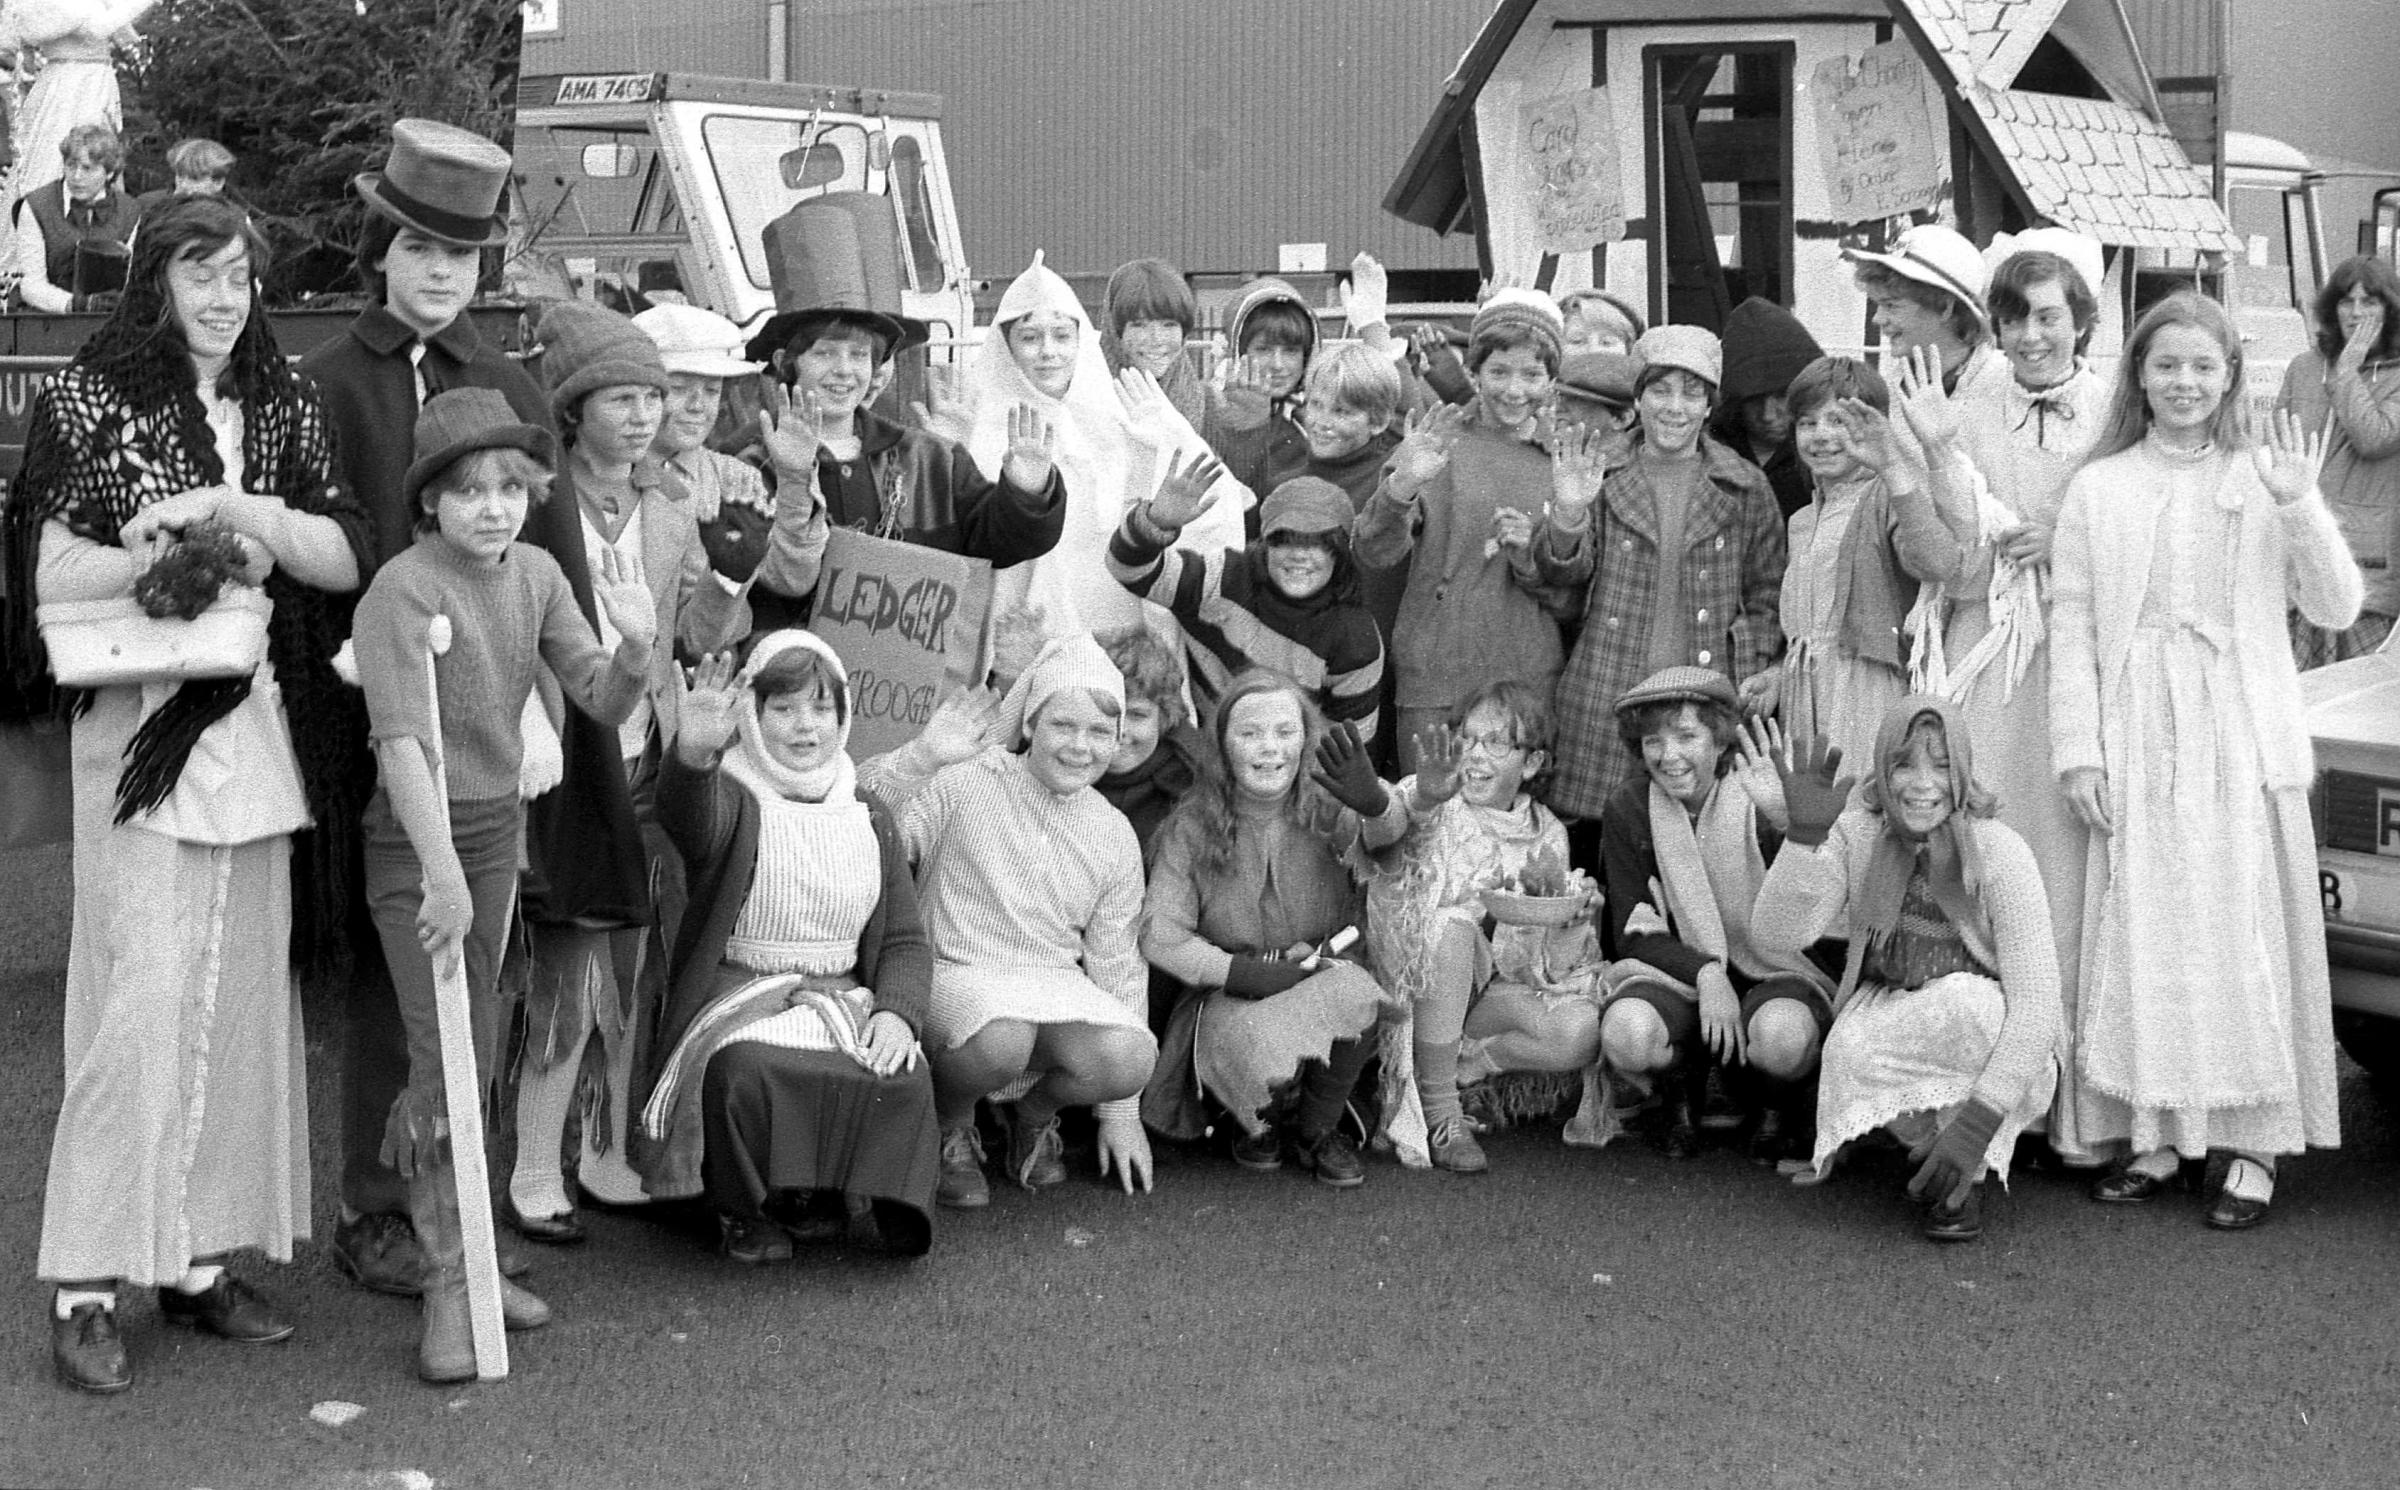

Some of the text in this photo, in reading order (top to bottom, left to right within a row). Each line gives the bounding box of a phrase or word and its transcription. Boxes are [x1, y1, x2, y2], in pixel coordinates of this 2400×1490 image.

[560, 81, 596, 99] AMA
[818, 567, 957, 654] LEDGER
[2319, 867, 2343, 910] B
